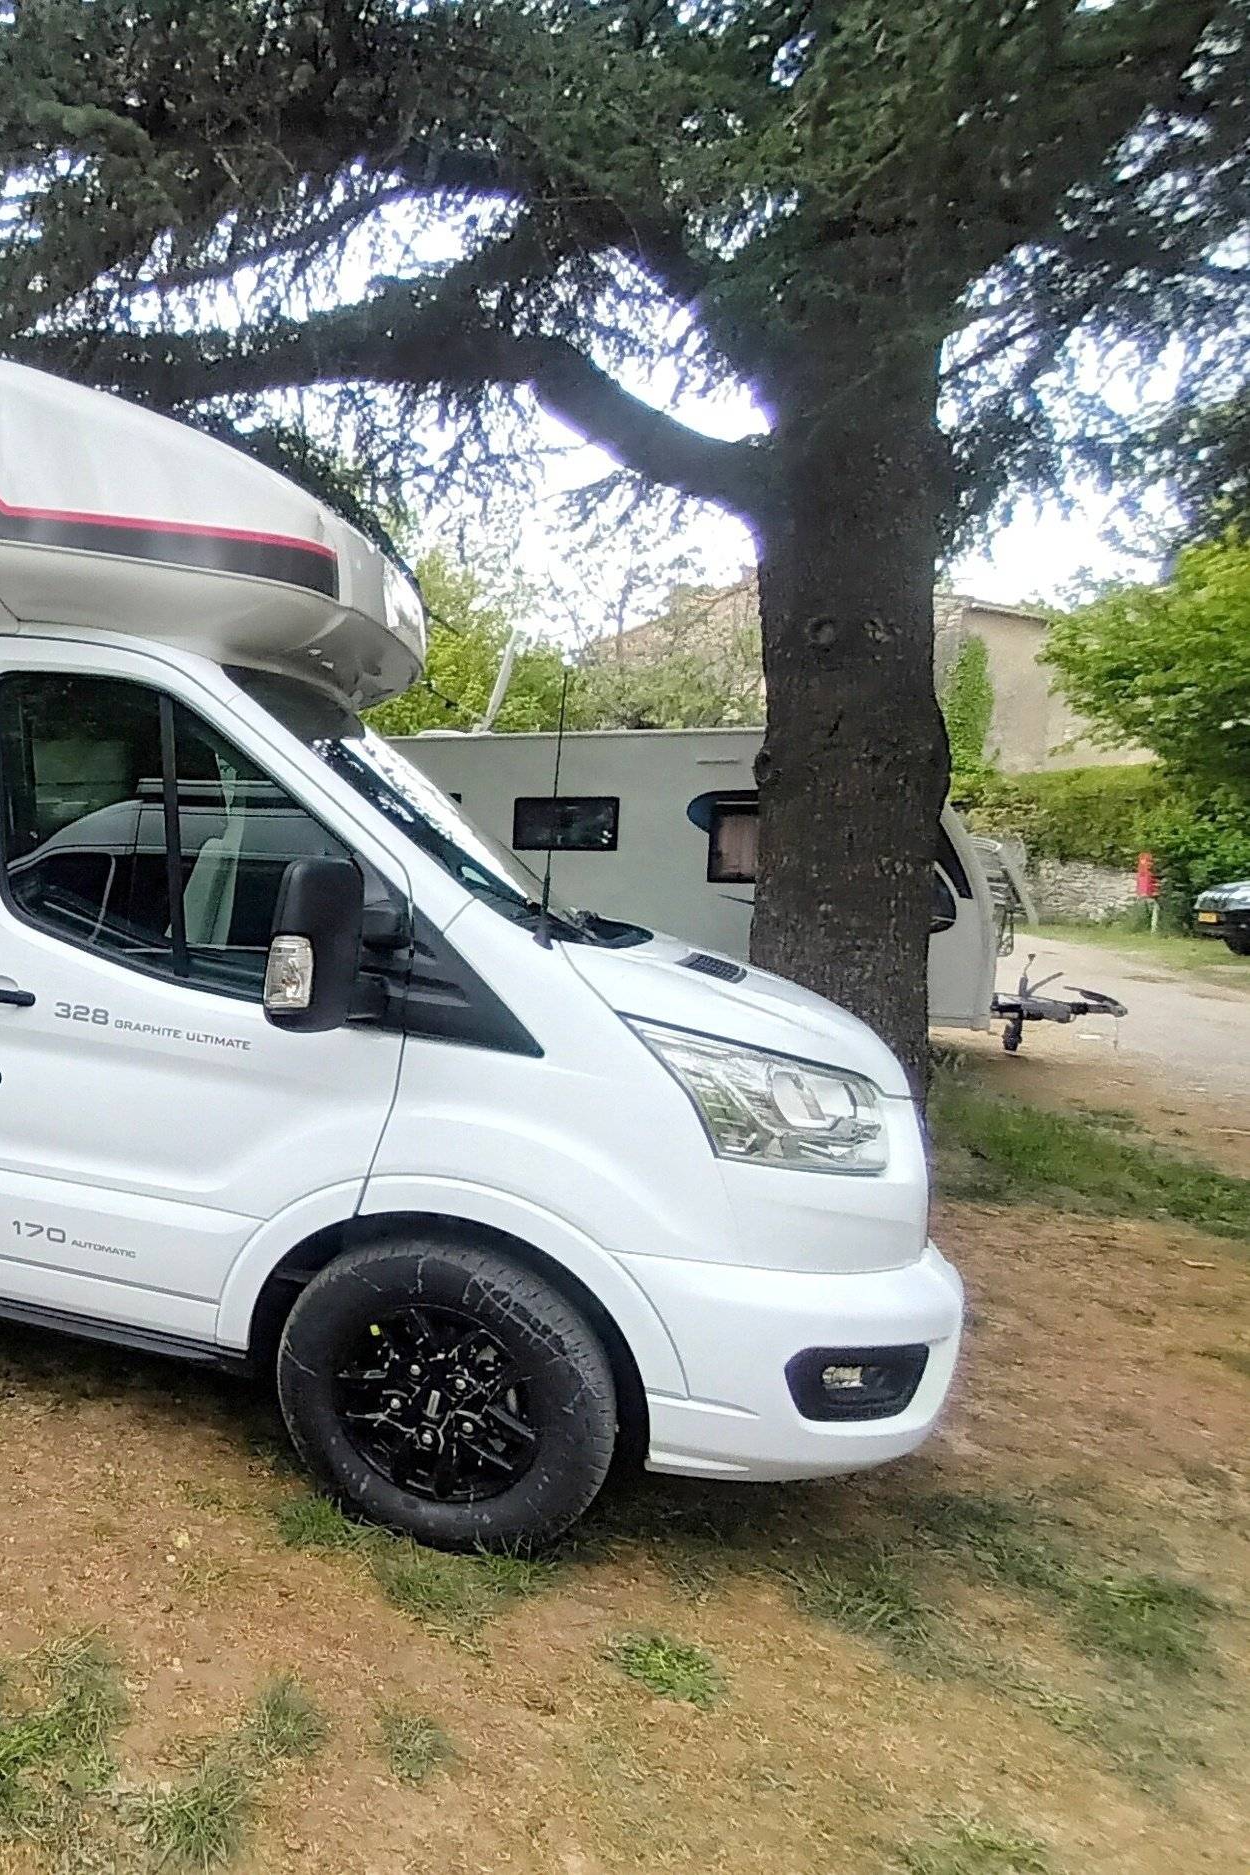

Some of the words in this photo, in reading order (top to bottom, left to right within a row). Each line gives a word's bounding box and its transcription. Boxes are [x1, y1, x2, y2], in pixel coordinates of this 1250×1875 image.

[53, 1001, 110, 1026] 328
[114, 1018, 182, 1039] GRAPHITE
[186, 1032, 251, 1050] ULTIMATE
[12, 1220, 66, 1244] 170
[71, 1239, 137, 1258] AUTOMATIC
